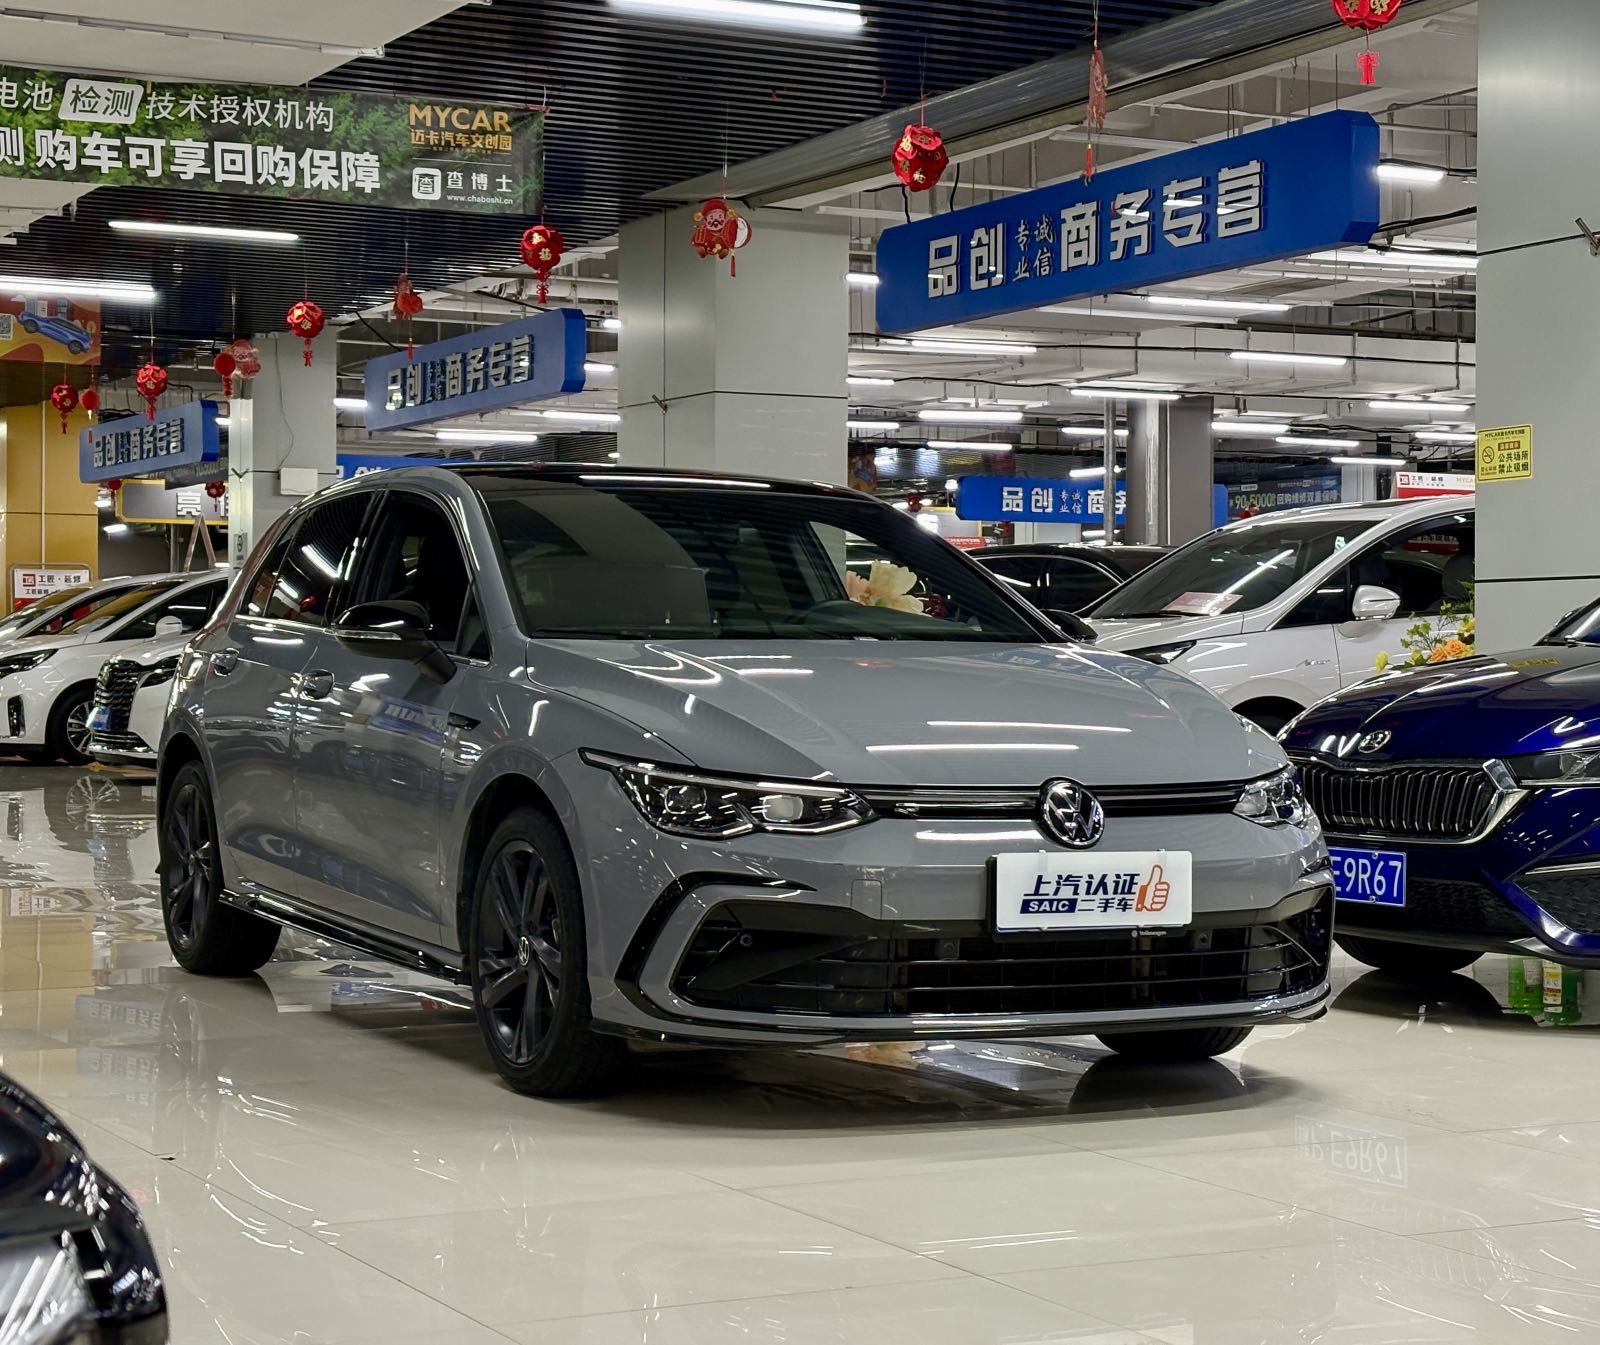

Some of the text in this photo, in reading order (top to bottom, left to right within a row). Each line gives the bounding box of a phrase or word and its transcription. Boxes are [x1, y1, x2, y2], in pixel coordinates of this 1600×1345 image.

[70, 84, 135, 118] 检测
[145, 91, 334, 132] 技术授权机构
[409, 103, 512, 132] MYCAR
[411, 129, 512, 151] 迈卡汽车文创园
[34, 128, 381, 193] 购车可享回购保障
[446, 171, 513, 192] 查博士
[446, 194, 513, 204] www.chaboshi.cn
[928, 222, 1005, 298] 品创
[1061, 160, 1262, 272] 商务专营
[1002, 487, 1053, 513] 品创
[1023, 873, 1140, 897] 上汽认证
[1028, 901, 1070, 912] SAIC
[1077, 897, 1135, 913] 二手车
